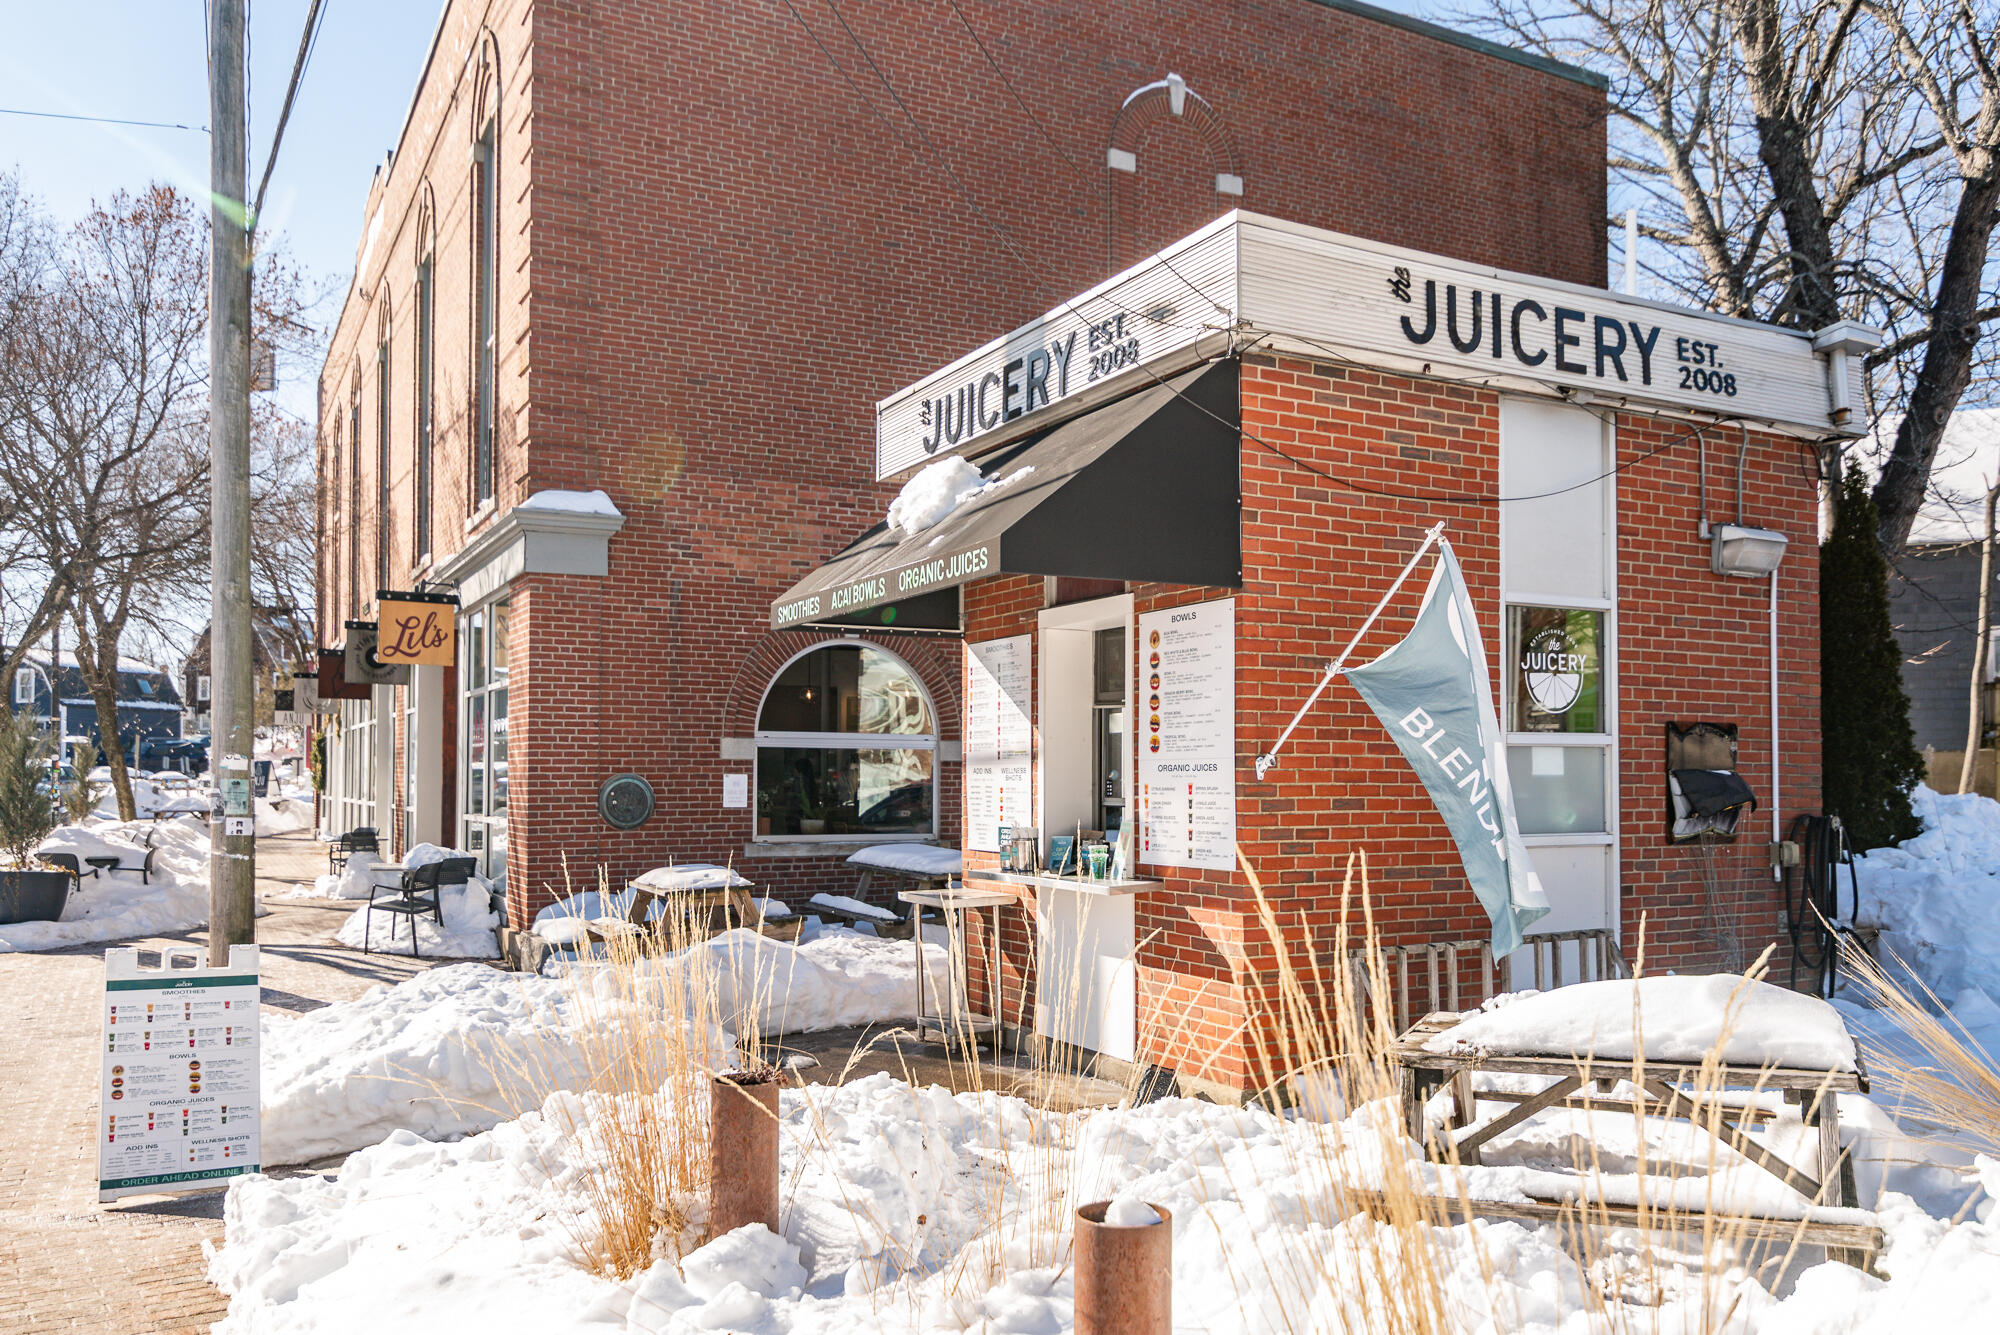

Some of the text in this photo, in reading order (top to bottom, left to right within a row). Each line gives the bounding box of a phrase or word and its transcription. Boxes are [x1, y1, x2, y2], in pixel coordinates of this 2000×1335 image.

[1387, 266, 1411, 303] the
[1088, 312, 1129, 353] EST.
[1401, 280, 1661, 386] JUICERY
[1088, 338, 1139, 381] 2008
[1677, 337, 1723, 368] EST.
[923, 331, 1077, 454] JUICERY
[1678, 366, 1737, 396] 2008
[898, 547, 988, 592] ORGANIC JUICES
[831, 577, 885, 610] ACAI BOWLS
[778, 596, 820, 624] SMOOTHIES
[1171, 612, 1197, 623] BOWLS
[354, 634, 377, 651] VINY
[382, 611, 448, 658] Lil's
[1548, 637, 1560, 651] the
[1521, 652, 1587, 672] JUICERY
[1157, 763, 1218, 772] ORGANIC JUICES
[149, 1098, 186, 1106] ORGANIC
[191, 1137, 227, 1145] WELLNESS
[121, 1167, 240, 1187] ORDER AHEAD ONLINE
